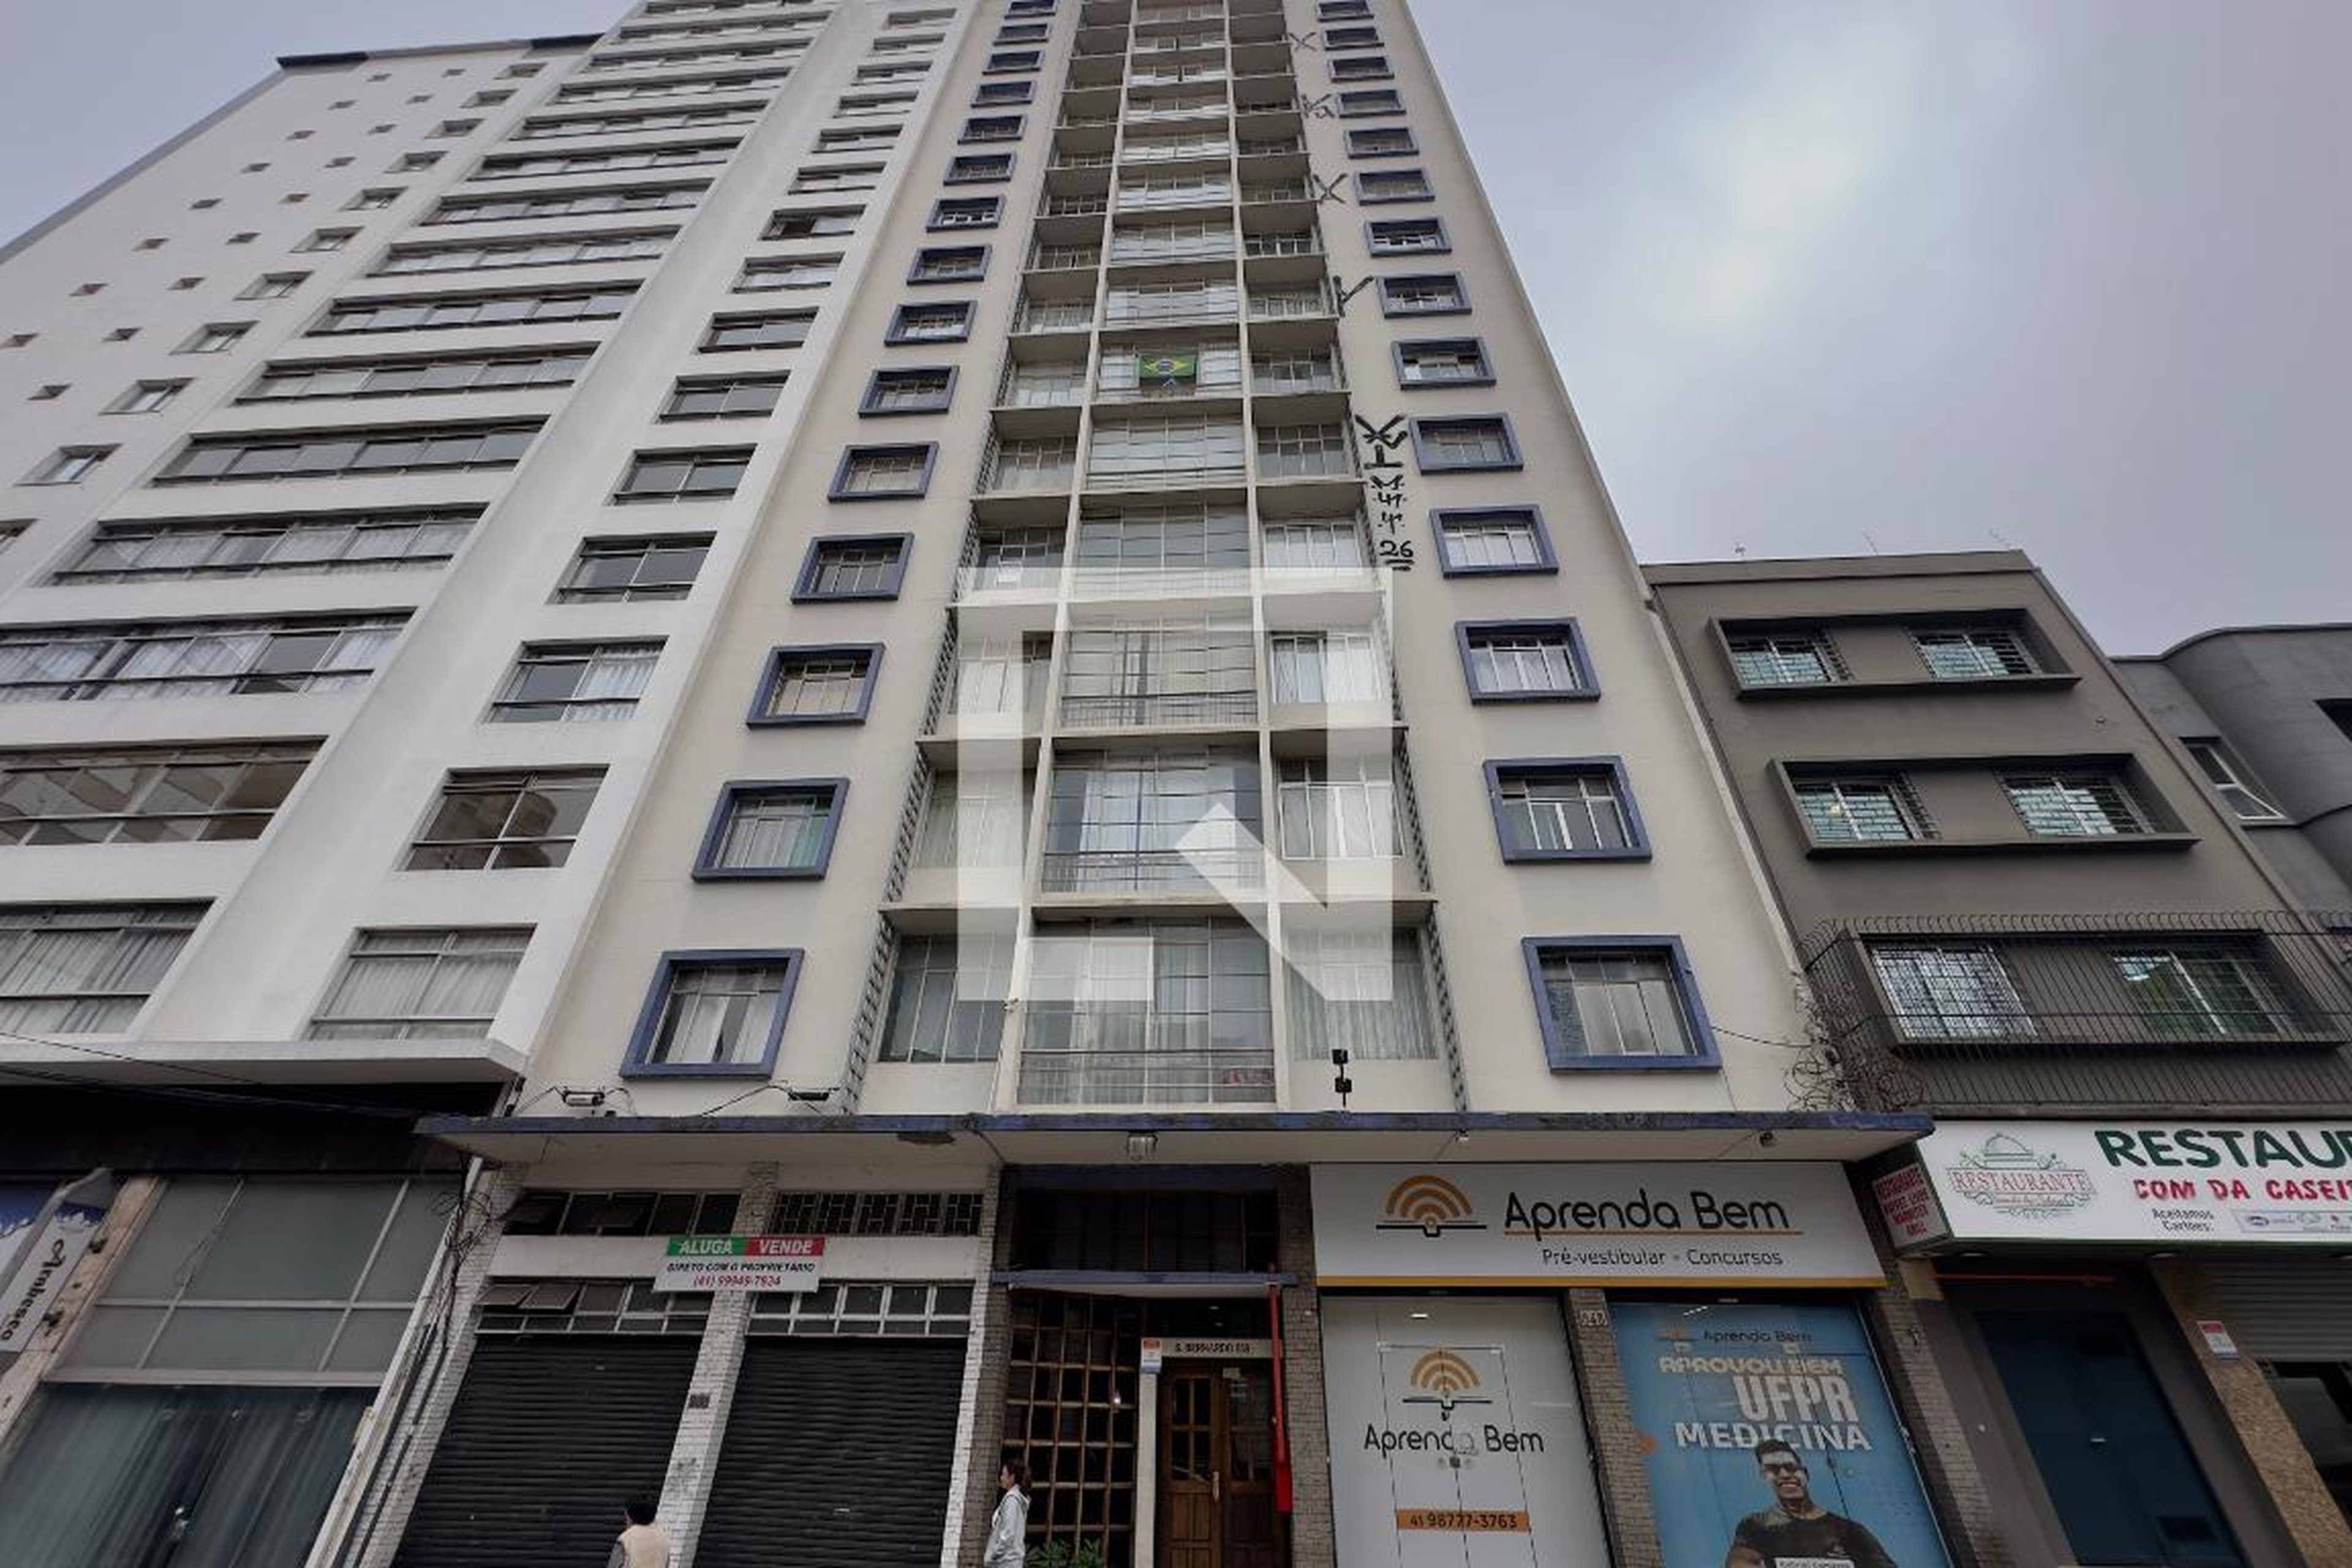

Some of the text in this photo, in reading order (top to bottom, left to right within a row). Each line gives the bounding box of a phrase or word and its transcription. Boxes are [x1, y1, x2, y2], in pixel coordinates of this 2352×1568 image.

[1953, 1171, 2087, 1191] RESTAURANTE
[2133, 1179, 2196, 1200] COM
[2206, 1179, 2250, 1200] DA
[1504, 1188, 1790, 1242] Aprenda Bem
[679, 1239, 813, 1254] ALUGA VENDE
[1542, 1248, 1667, 1265] Pré-vestibular
[1687, 1248, 1783, 1265] Concursos
[1732, 1375, 1858, 1422] UFPR
[1363, 1423, 1544, 1459] Aprend Bem
[1674, 1422, 1872, 1450] MEDICINA
